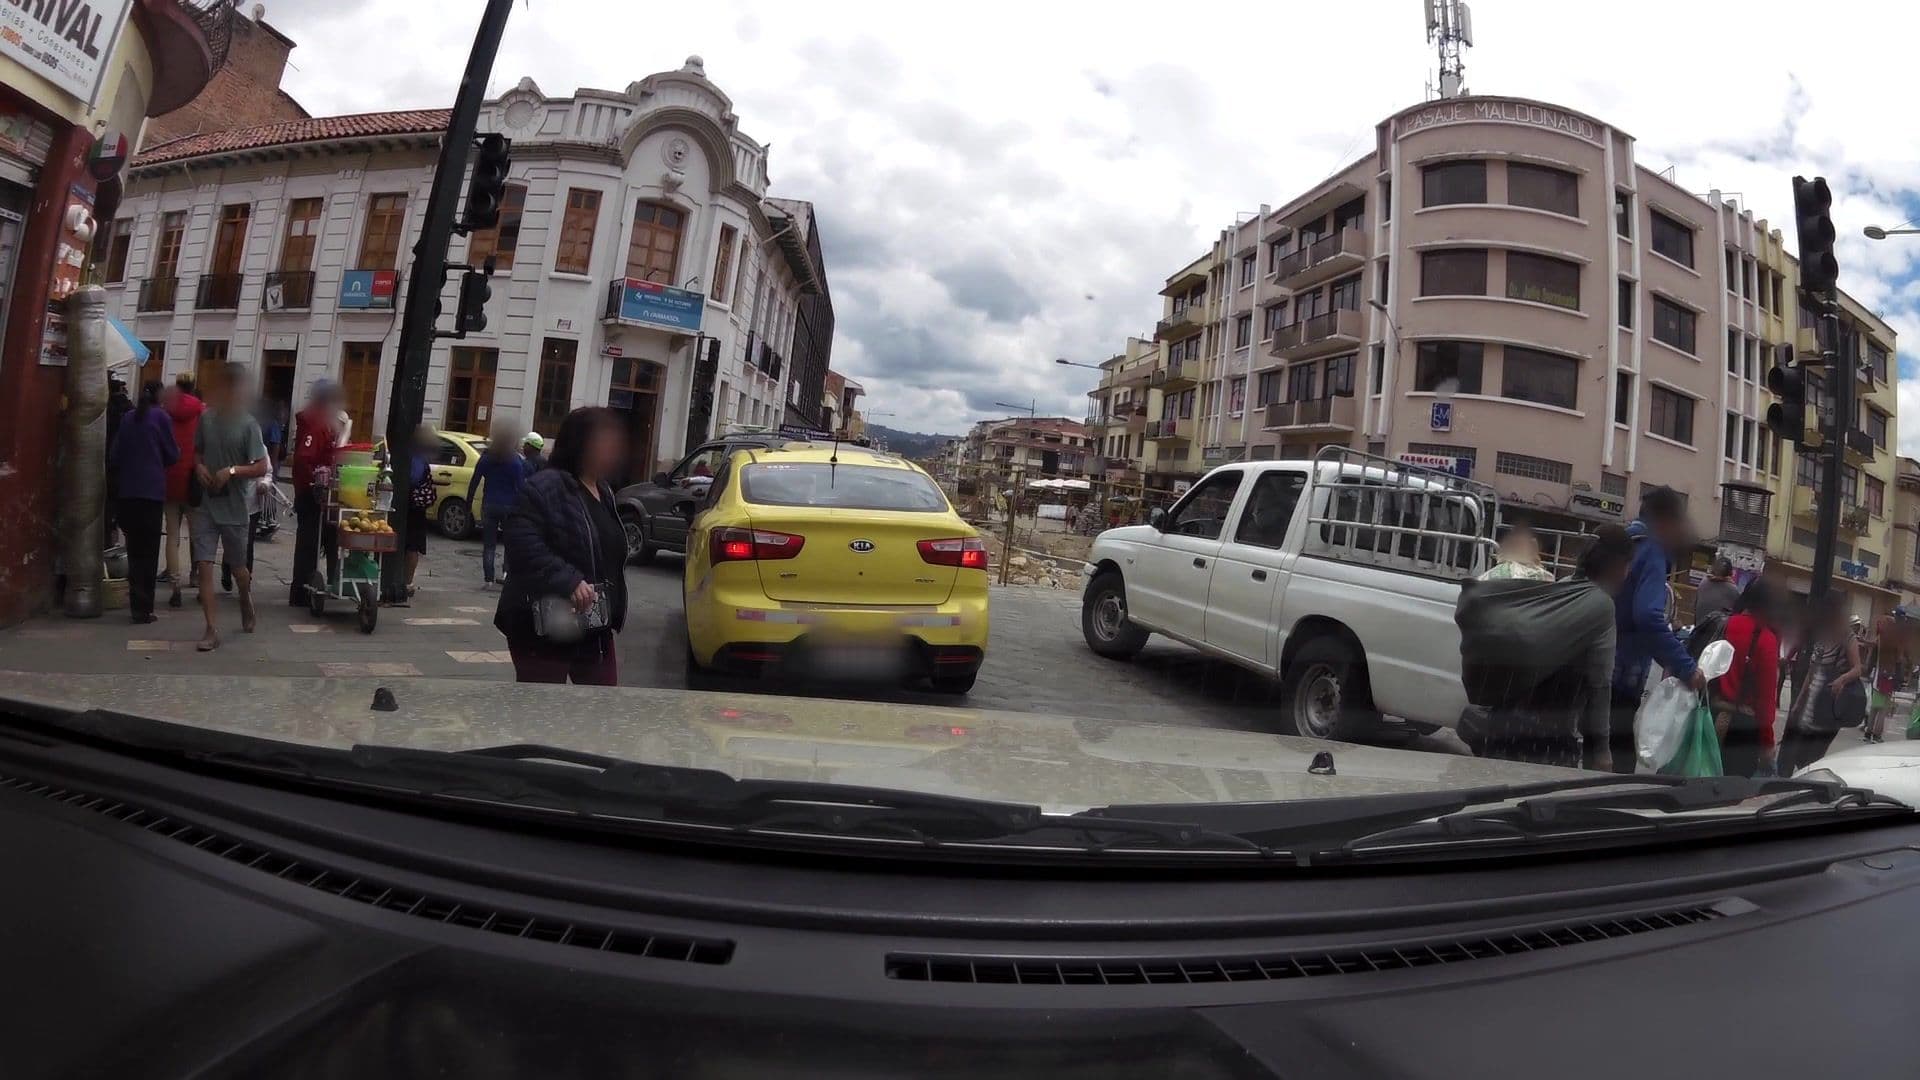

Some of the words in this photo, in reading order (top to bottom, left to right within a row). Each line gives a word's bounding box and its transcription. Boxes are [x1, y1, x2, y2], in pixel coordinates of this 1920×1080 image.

[1406, 102, 1467, 132] PASAJE
[1473, 102, 1594, 139] MALDONADO
[304, 434, 313, 447] 3
[1400, 454, 1449, 466] FARMACIAS
[853, 541, 871, 550] KIA
